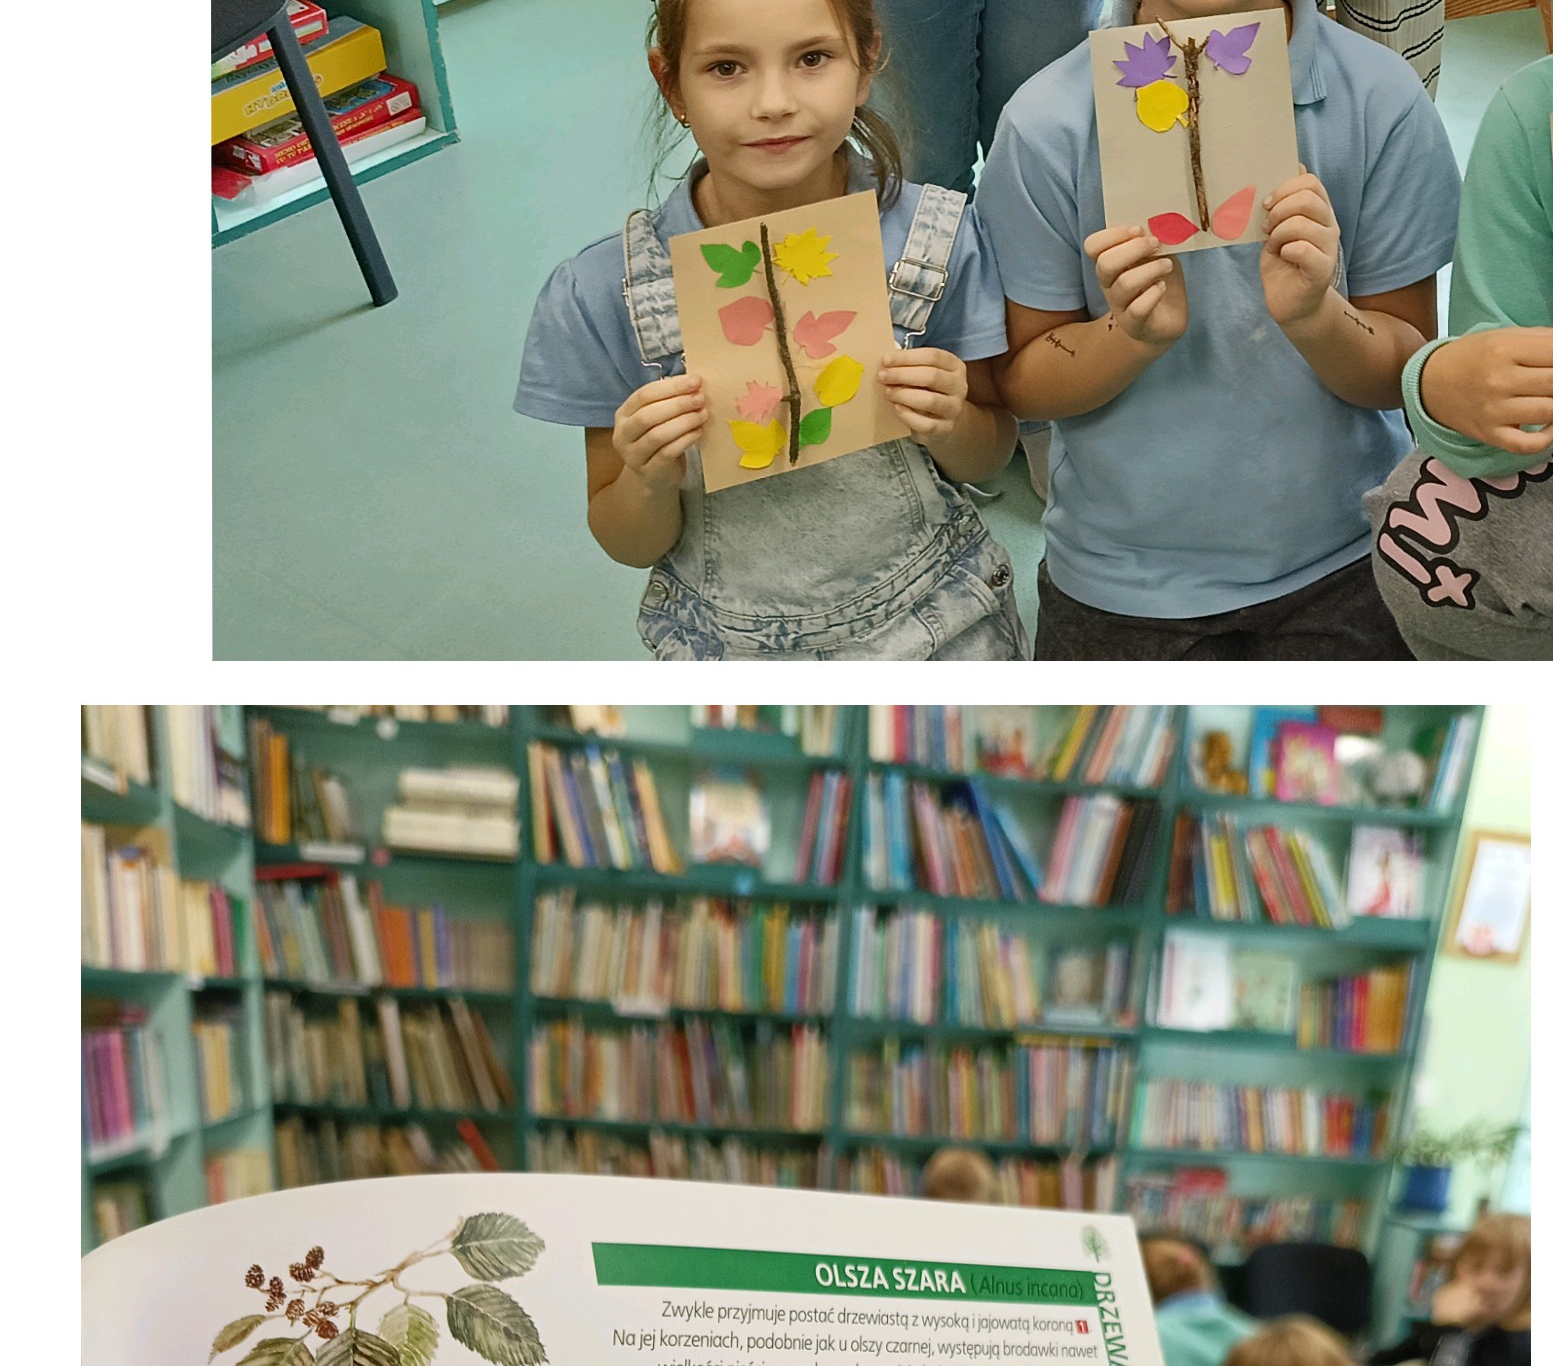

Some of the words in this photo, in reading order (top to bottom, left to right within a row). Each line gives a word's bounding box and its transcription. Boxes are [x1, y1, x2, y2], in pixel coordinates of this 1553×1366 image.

[815, 1263, 889, 1291] OLSZA
[892, 1267, 967, 1294] SZARA
[970, 1273, 1022, 1298] (Alnus
[1027, 1275, 1084, 1301] incana)
[661, 1300, 714, 1323] Zwykle
[717, 1303, 786, 1326] przyjmuje
[789, 1307, 835, 1326] postać
[837, 1307, 909, 1331] drzewiastą
[912, 1315, 919, 1327] z
[921, 1312, 969, 1333] wysoką
[972, 1315, 975, 1329] i
[977, 1317, 1030, 1334] jajowatą
[1032, 1315, 1074, 1334] koroną
[613, 1329, 636, 1346] Na
[638, 1329, 656, 1351] jej
[659, 1328, 743, 1351] korzeniach,
[746, 1332, 813, 1353] podobnie
[814, 1334, 836, 1355] jak
[839, 1339, 847, 1352] u
[850, 1335, 883, 1357] olszy
[885, 1338, 935, 1358] czarnej,
[937, 1341, 1000, 1360] występują
[1003, 1340, 1058, 1357] brodawki
[1061, 1345, 1097, 1358] nawet
